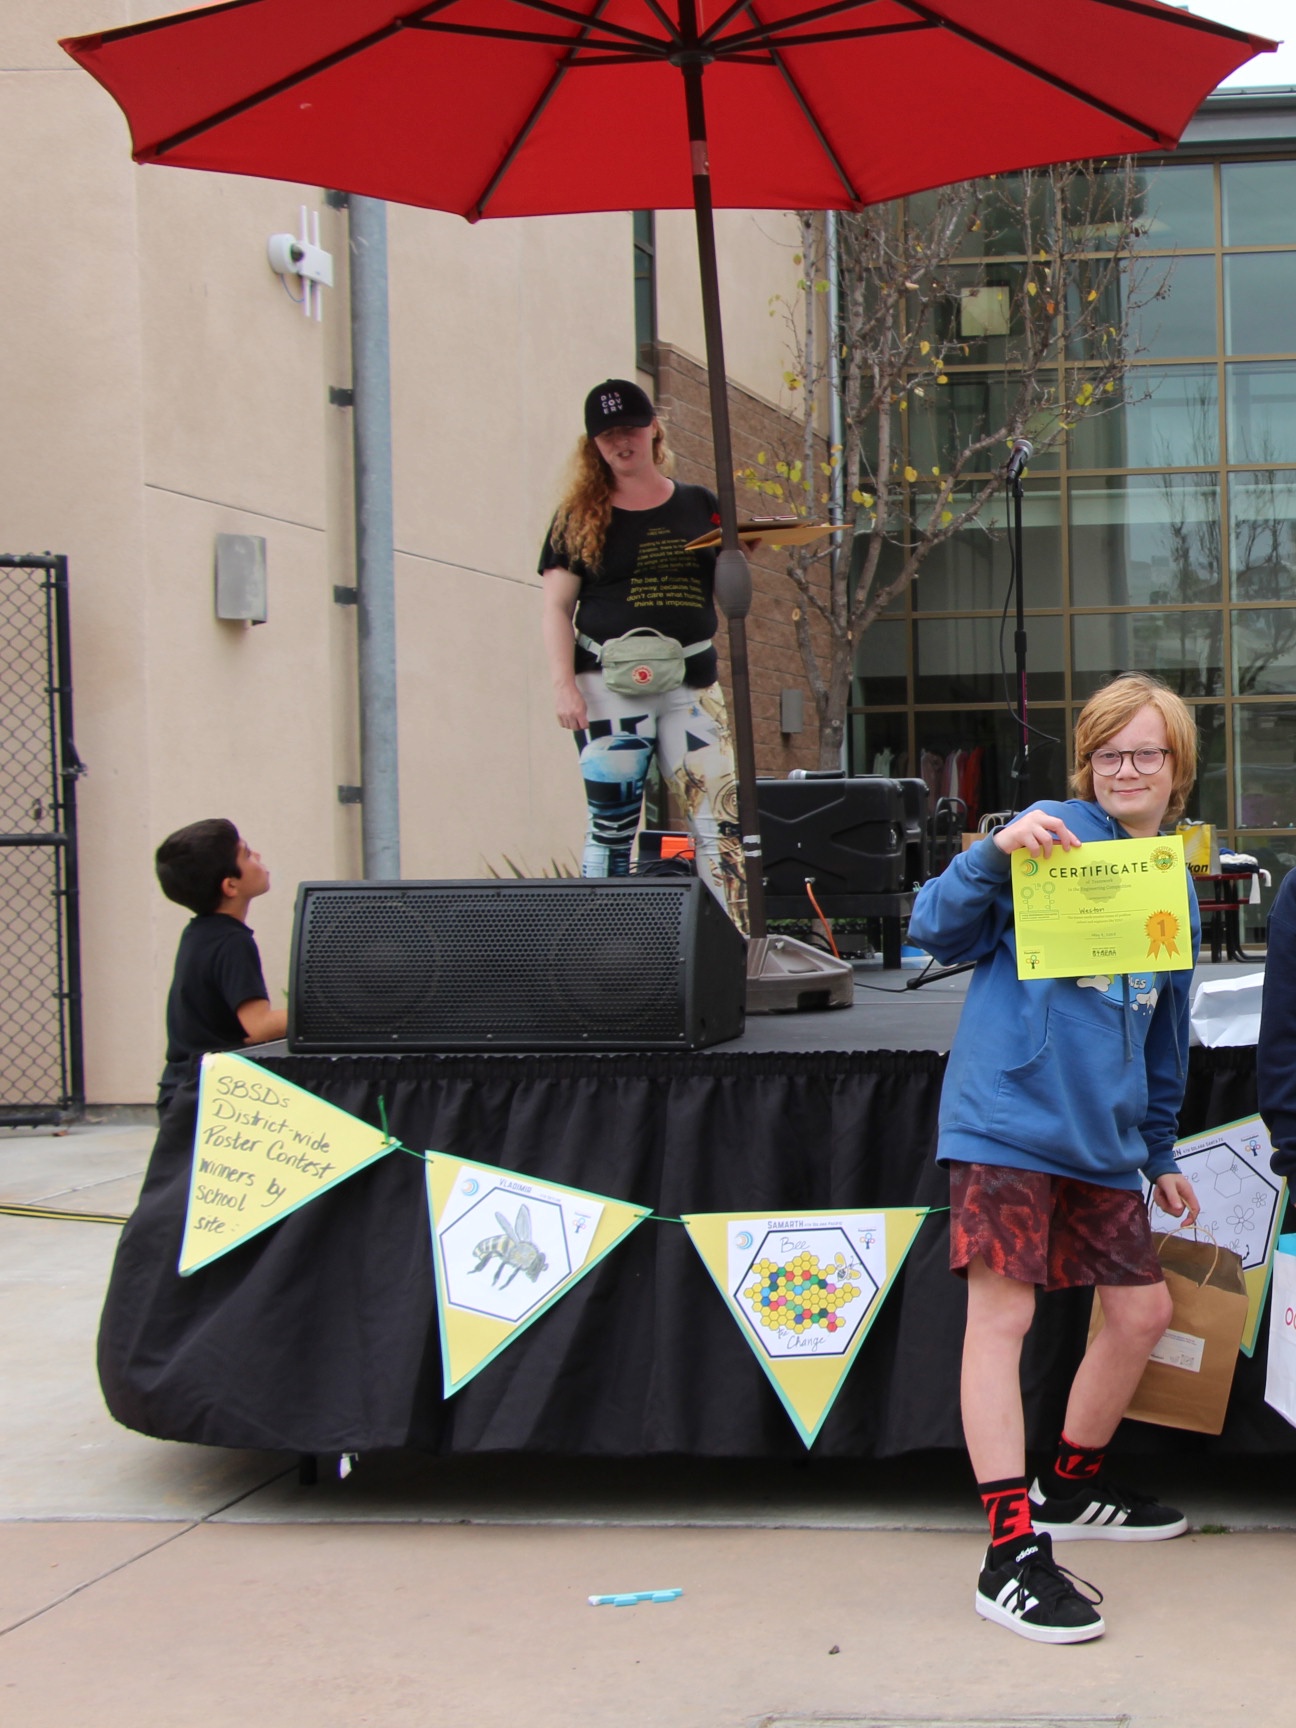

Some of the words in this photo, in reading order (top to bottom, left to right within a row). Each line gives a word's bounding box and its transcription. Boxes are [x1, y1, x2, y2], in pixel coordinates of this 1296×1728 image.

[1049, 861, 1149, 879] CERTIFICATE
[1185, 862, 1209, 873] kon
[1157, 919, 1166, 937] 1
[216, 1075, 291, 1109] SBSDs
[211, 1097, 331, 1154] District-wide
[202, 1124, 262, 1153] Poster
[265, 1140, 337, 1180] Contest
[198, 1157, 256, 1187] winners
[260, 1177, 287, 1208] by
[499, 1177, 533, 1193] VLADIMIR
[767, 1220, 804, 1230] SAMARTH
[780, 1236, 811, 1253] Bee
[786, 1335, 826, 1352] Change
[1015, 1545, 1039, 1563] adidas
